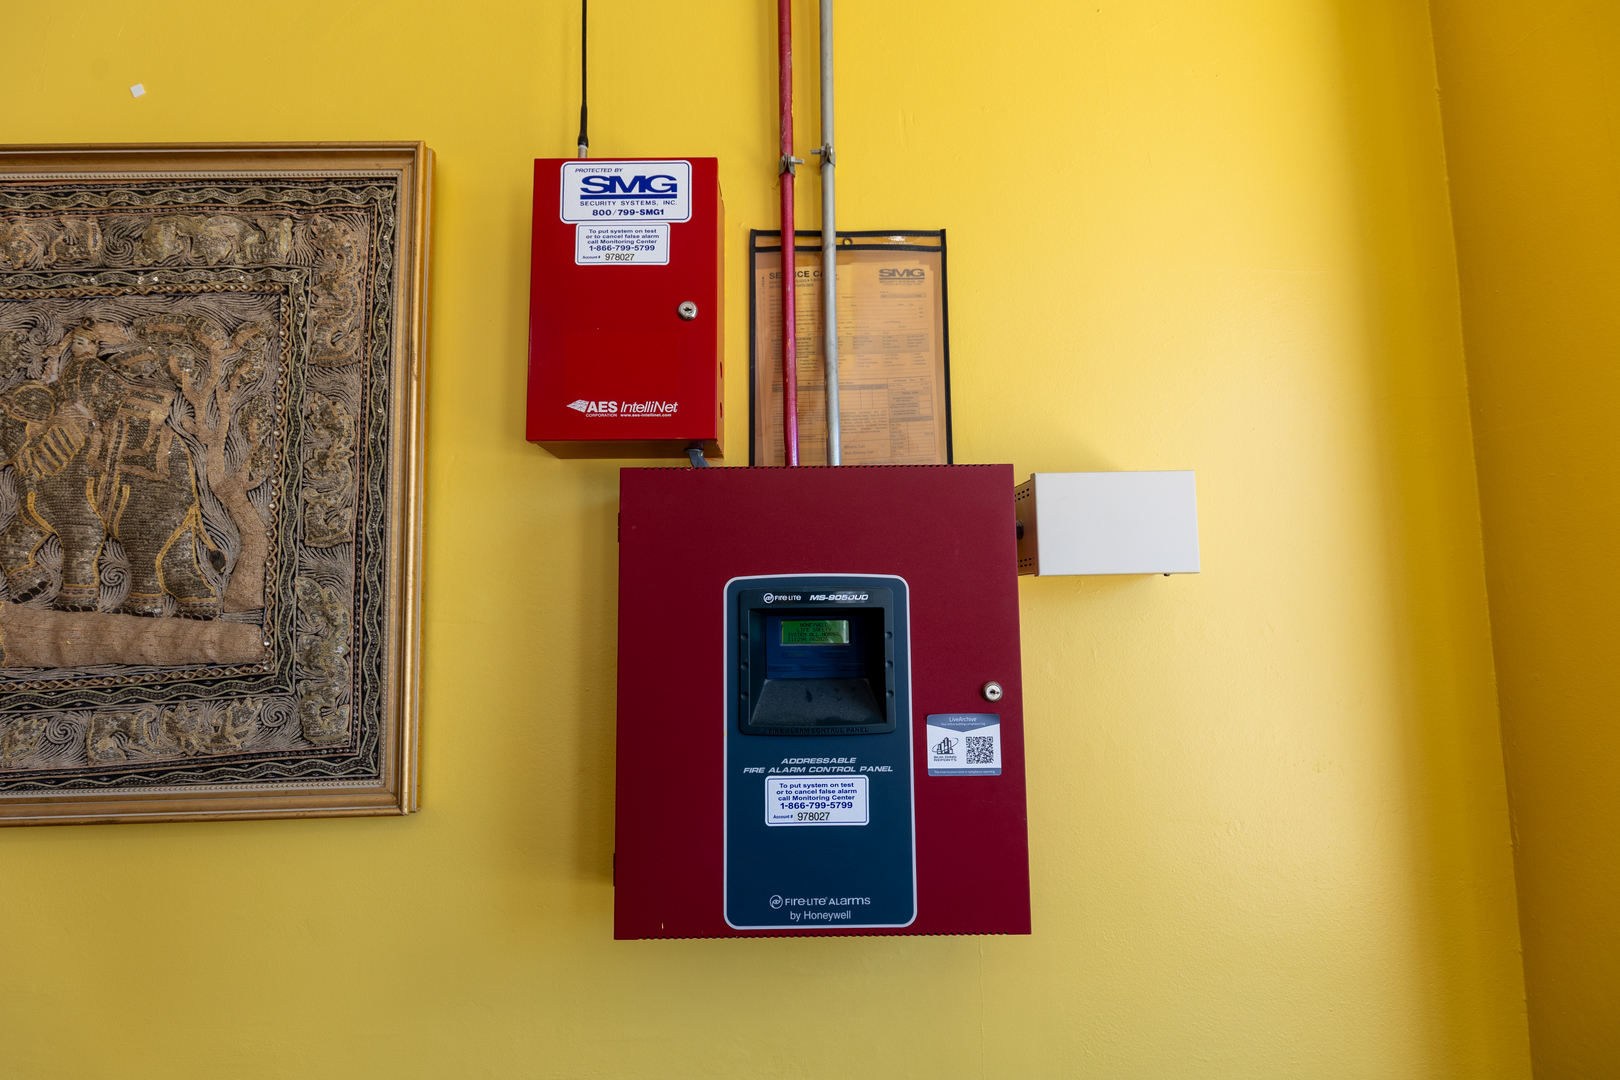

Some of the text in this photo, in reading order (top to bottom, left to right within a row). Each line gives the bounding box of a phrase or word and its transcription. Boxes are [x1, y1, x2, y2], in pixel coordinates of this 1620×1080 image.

[580, 174, 678, 194] SMG
[879, 268, 925, 277] SMG
[587, 401, 679, 413] AES IntelliNet
[797, 812, 830, 821] 978027
[790, 911, 851, 922] by Honeywell
